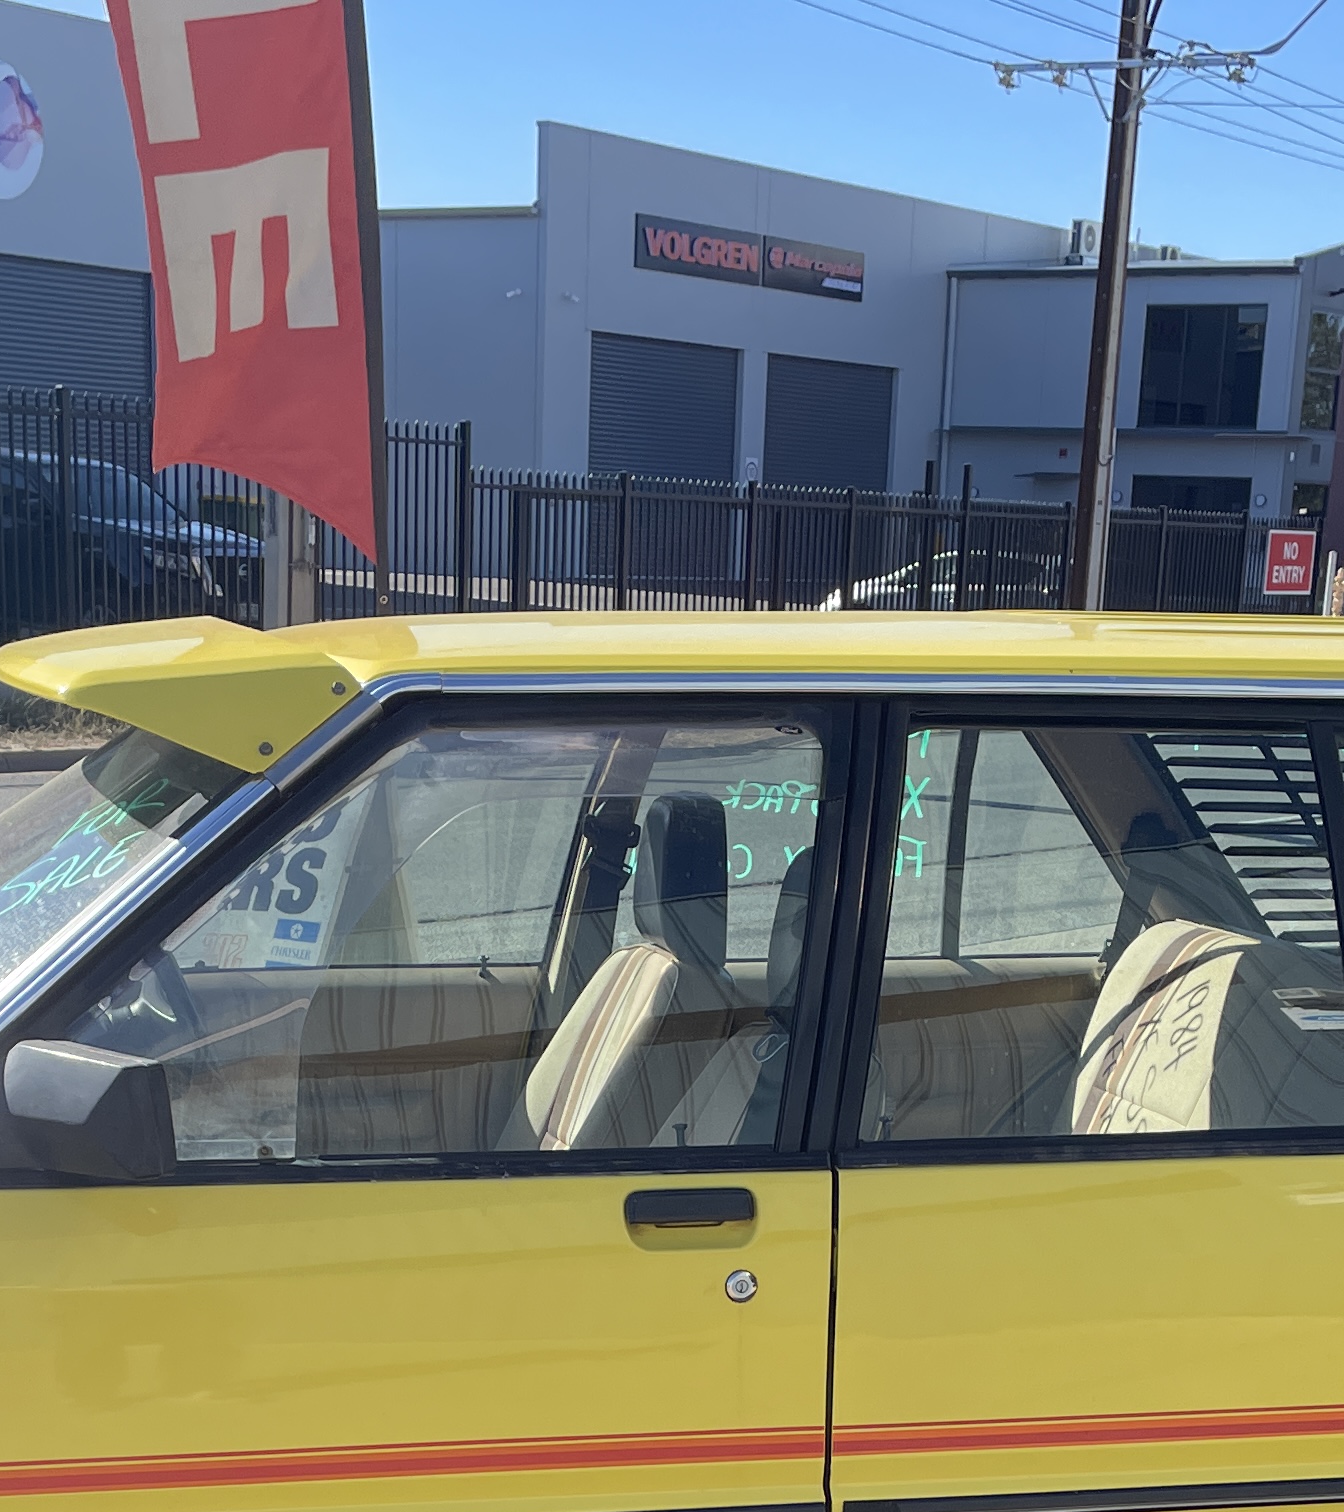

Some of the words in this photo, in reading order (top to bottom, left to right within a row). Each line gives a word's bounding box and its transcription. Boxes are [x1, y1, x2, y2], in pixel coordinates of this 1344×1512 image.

[644, 227, 758, 272] VOLGREN
[1283, 541, 1299, 560] NO
[1272, 566, 1306, 584] ENTRY
[217, 847, 327, 914] RS
[270, 945, 312, 960] CHRYSLER
[1162, 979, 1211, 1072] 1984
